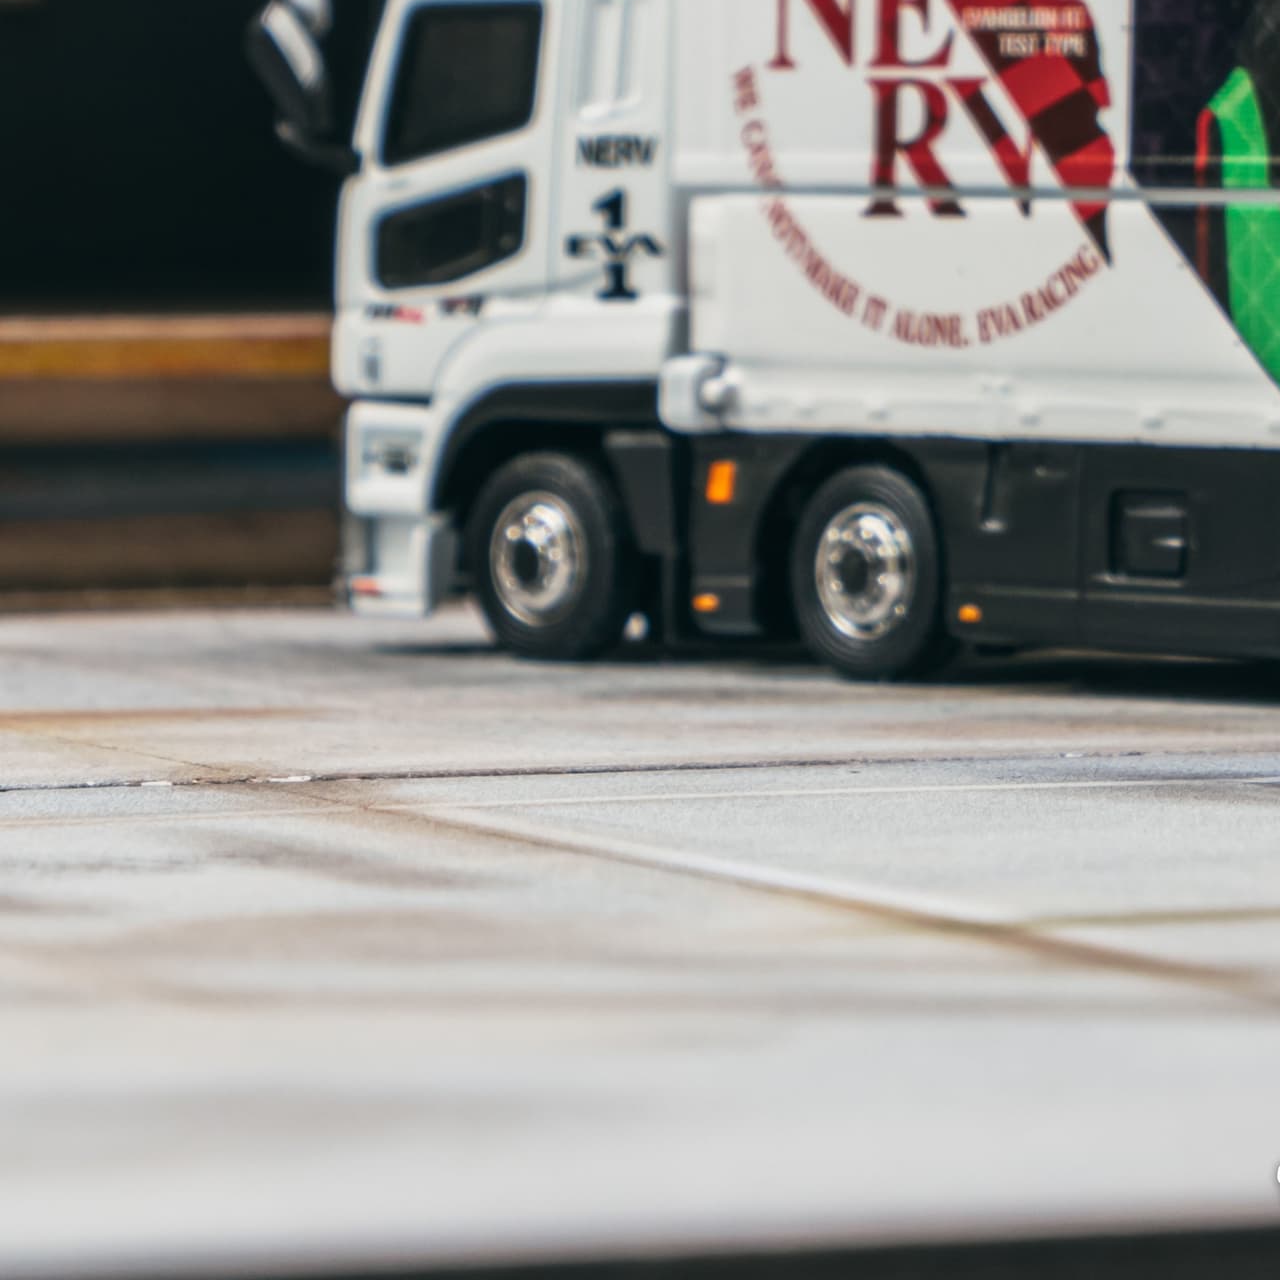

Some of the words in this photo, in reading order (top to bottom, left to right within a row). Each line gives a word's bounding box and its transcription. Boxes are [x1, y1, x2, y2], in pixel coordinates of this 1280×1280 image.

[999, 32, 1039, 56] TEST
[1045, 33, 1088, 56] TYPE
[578, 135, 655, 167] NERV
[861, 294, 888, 331] IT
[976, 303, 1023, 345] EVA
[1019, 244, 1103, 326] RACING
